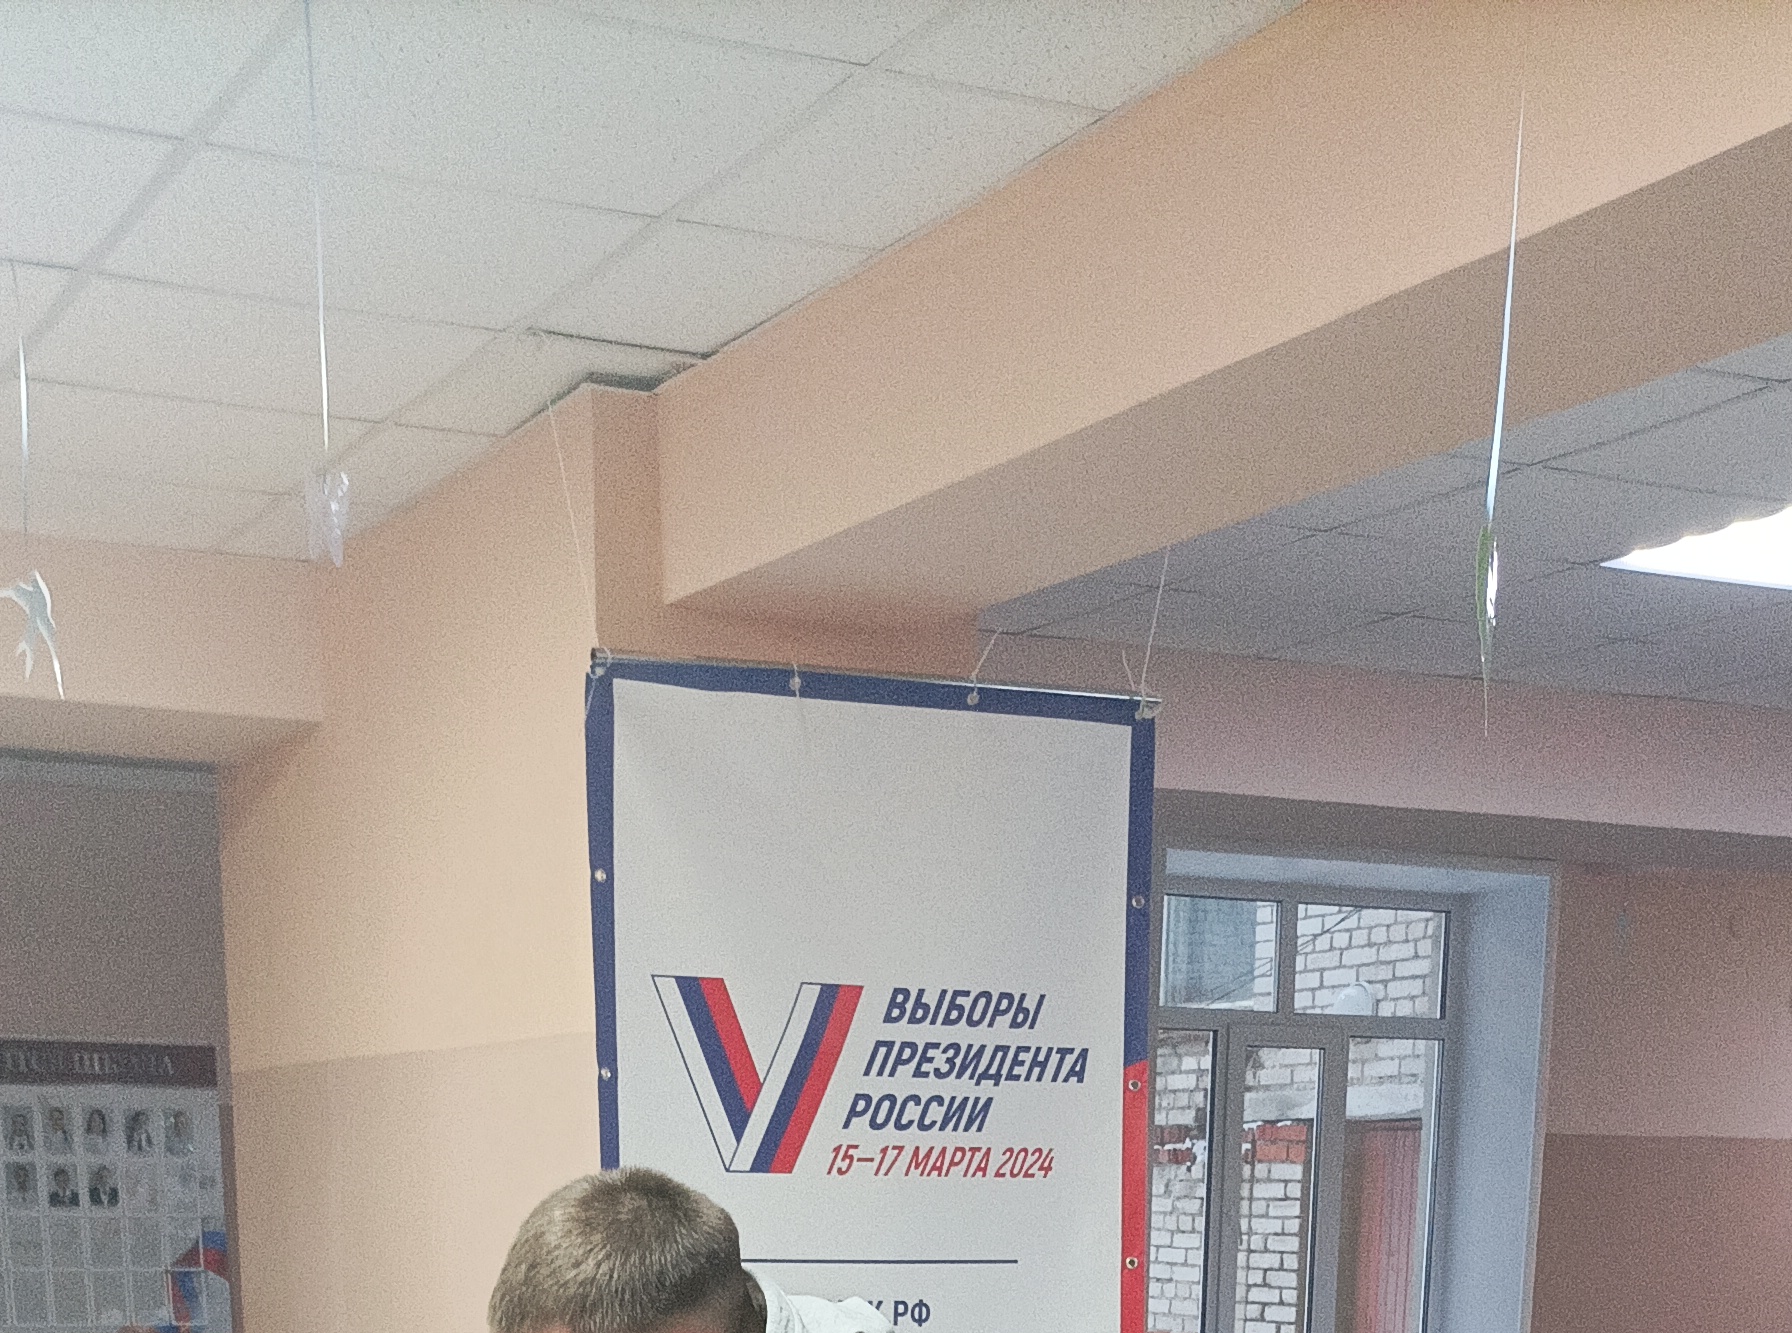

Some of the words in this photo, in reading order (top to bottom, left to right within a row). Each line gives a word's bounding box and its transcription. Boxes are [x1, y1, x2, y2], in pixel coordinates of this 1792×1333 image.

[882, 987, 1046, 1030] ВЫБОРЫ
[863, 1040, 1089, 1086] ПРЕЗИДЕНТА
[842, 1093, 993, 1133] РОССИИ
[904, 1145, 992, 1178] МАРТА
[994, 1146, 1054, 1179] 2024
[893, 1298, 931, 1327] РФ
